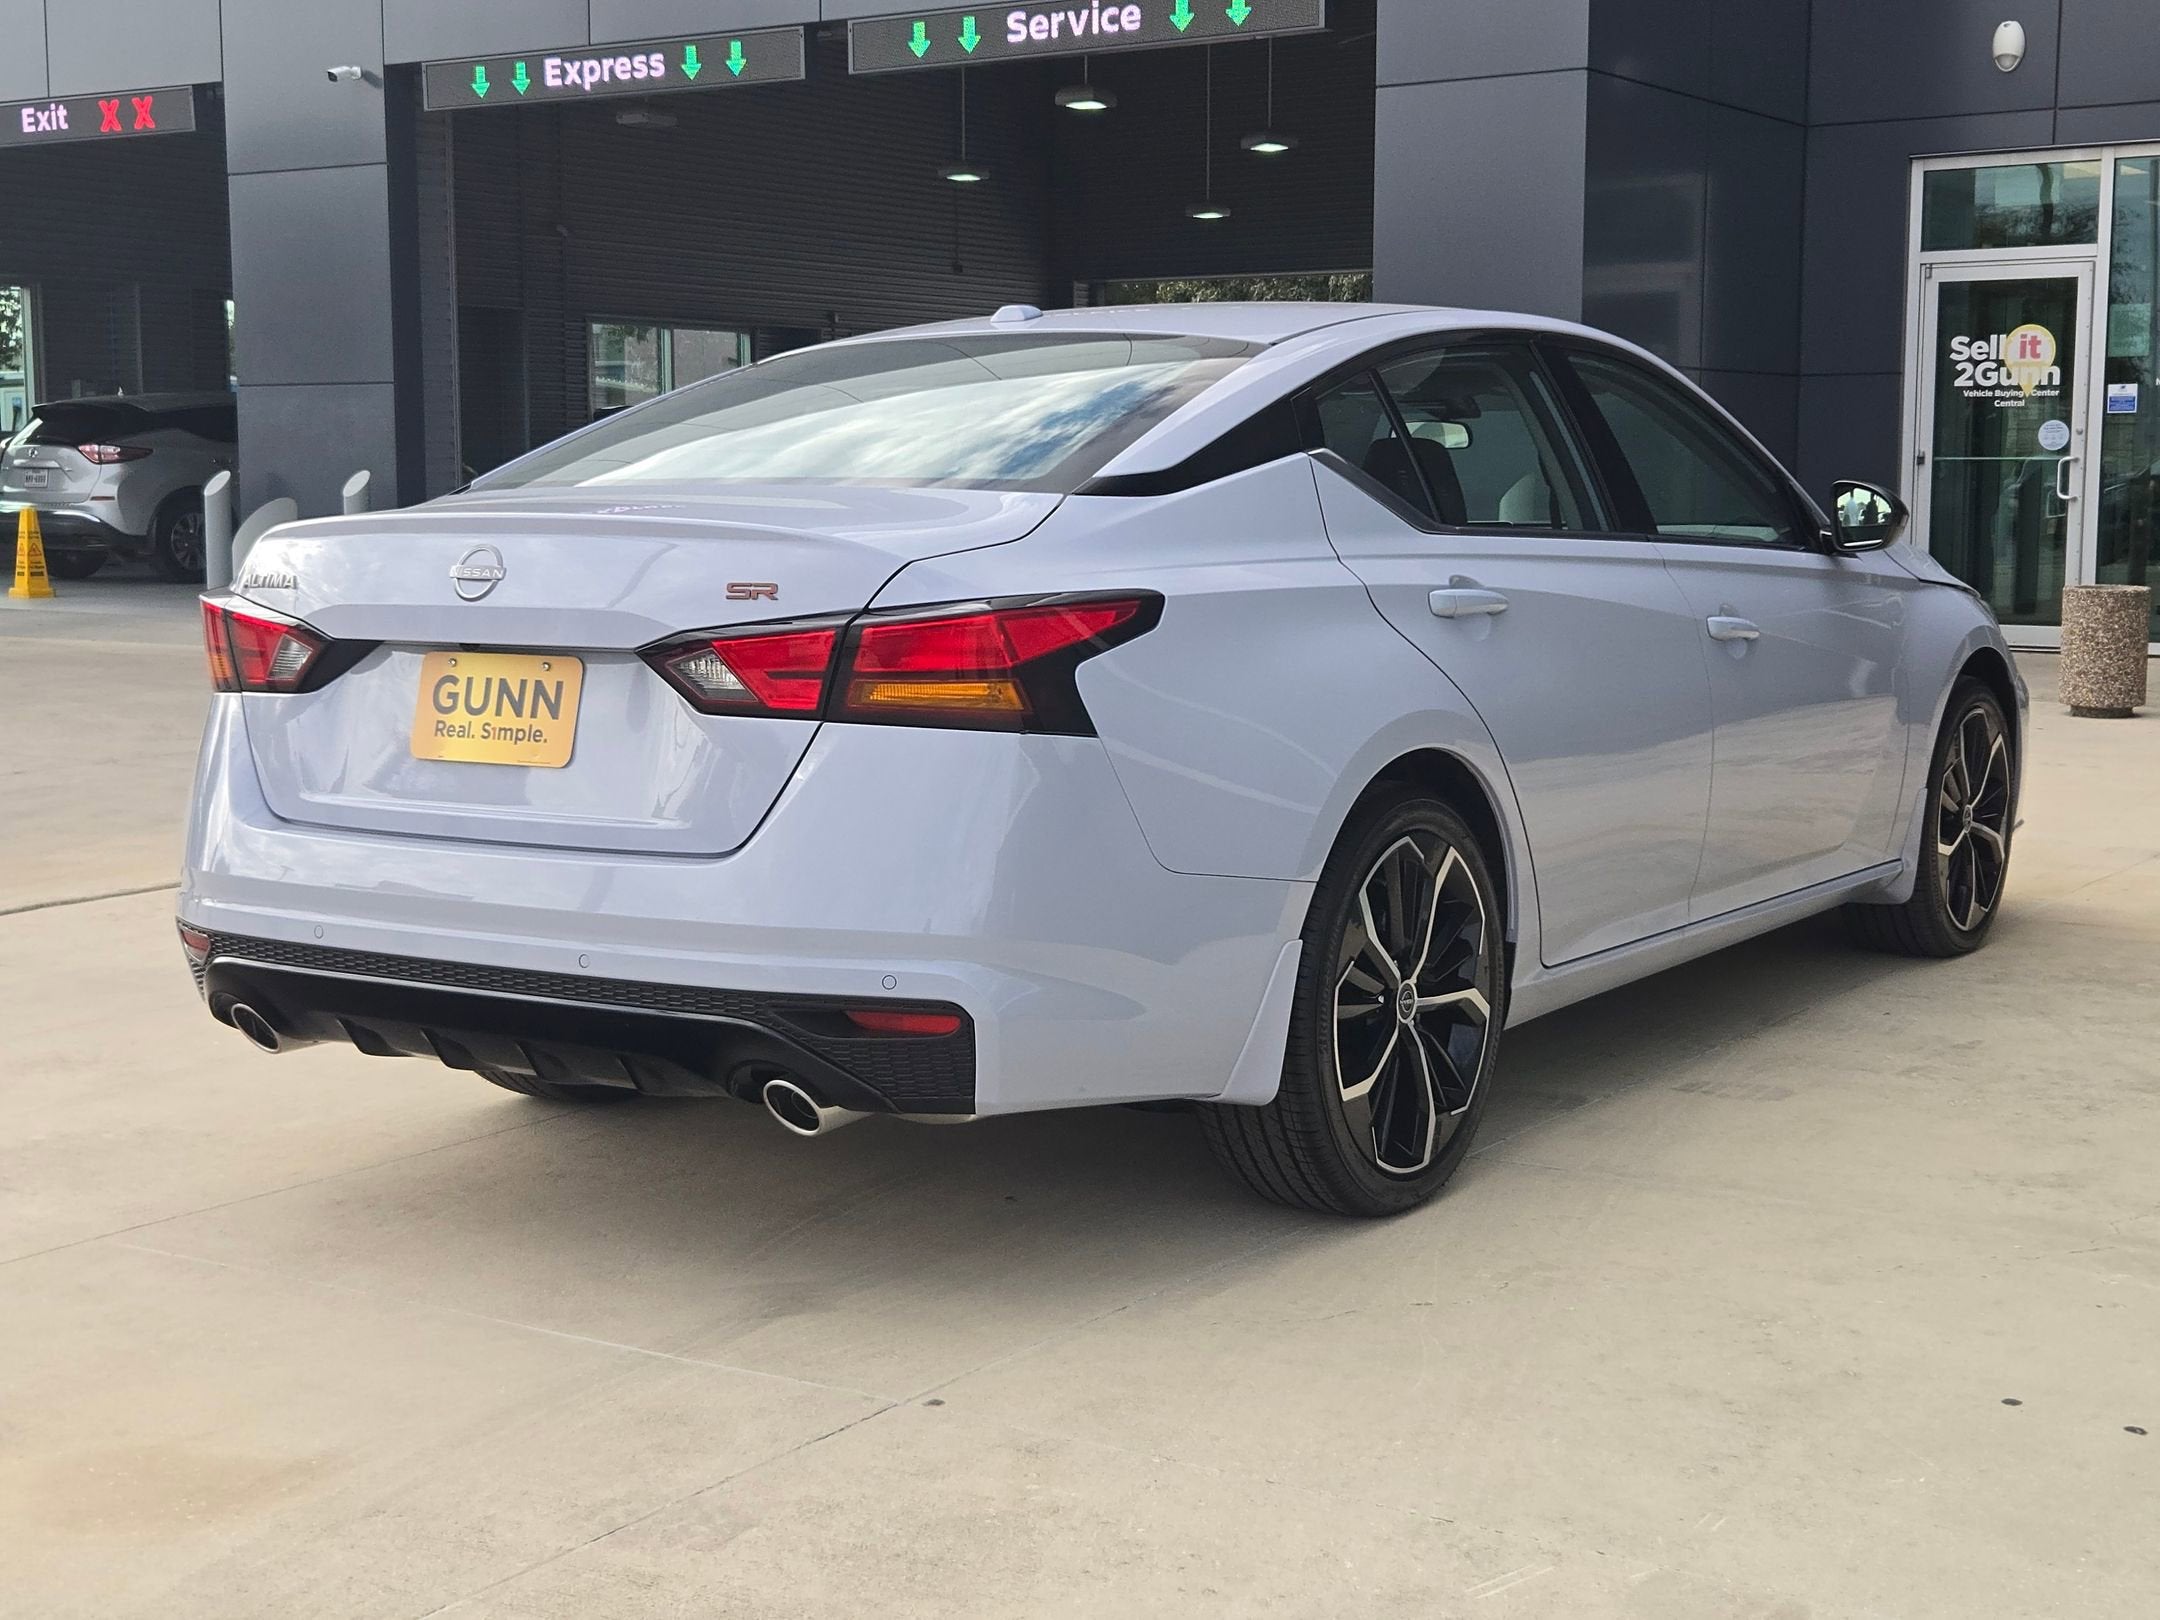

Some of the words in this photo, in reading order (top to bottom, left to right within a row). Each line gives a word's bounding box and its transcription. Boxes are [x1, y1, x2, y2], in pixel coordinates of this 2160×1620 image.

[1006, 0, 1142, 43] Service
[543, 52, 665, 91] Express
[21, 103, 69, 133] Exit
[1949, 334, 2008, 361] Sell
[2020, 334, 2042, 359] it
[1954, 361, 2061, 387] 2Gunn
[1963, 389, 1994, 397] Vehicle
[1994, 389, 2024, 399] Buying
[2031, 389, 2060, 397] Center
[242, 573, 297, 590] ALTIMA
[450, 566, 505, 579] NISSAN
[725, 582, 779, 600] SR
[432, 674, 564, 720] GUNN
[434, 720, 475, 739] Real.
